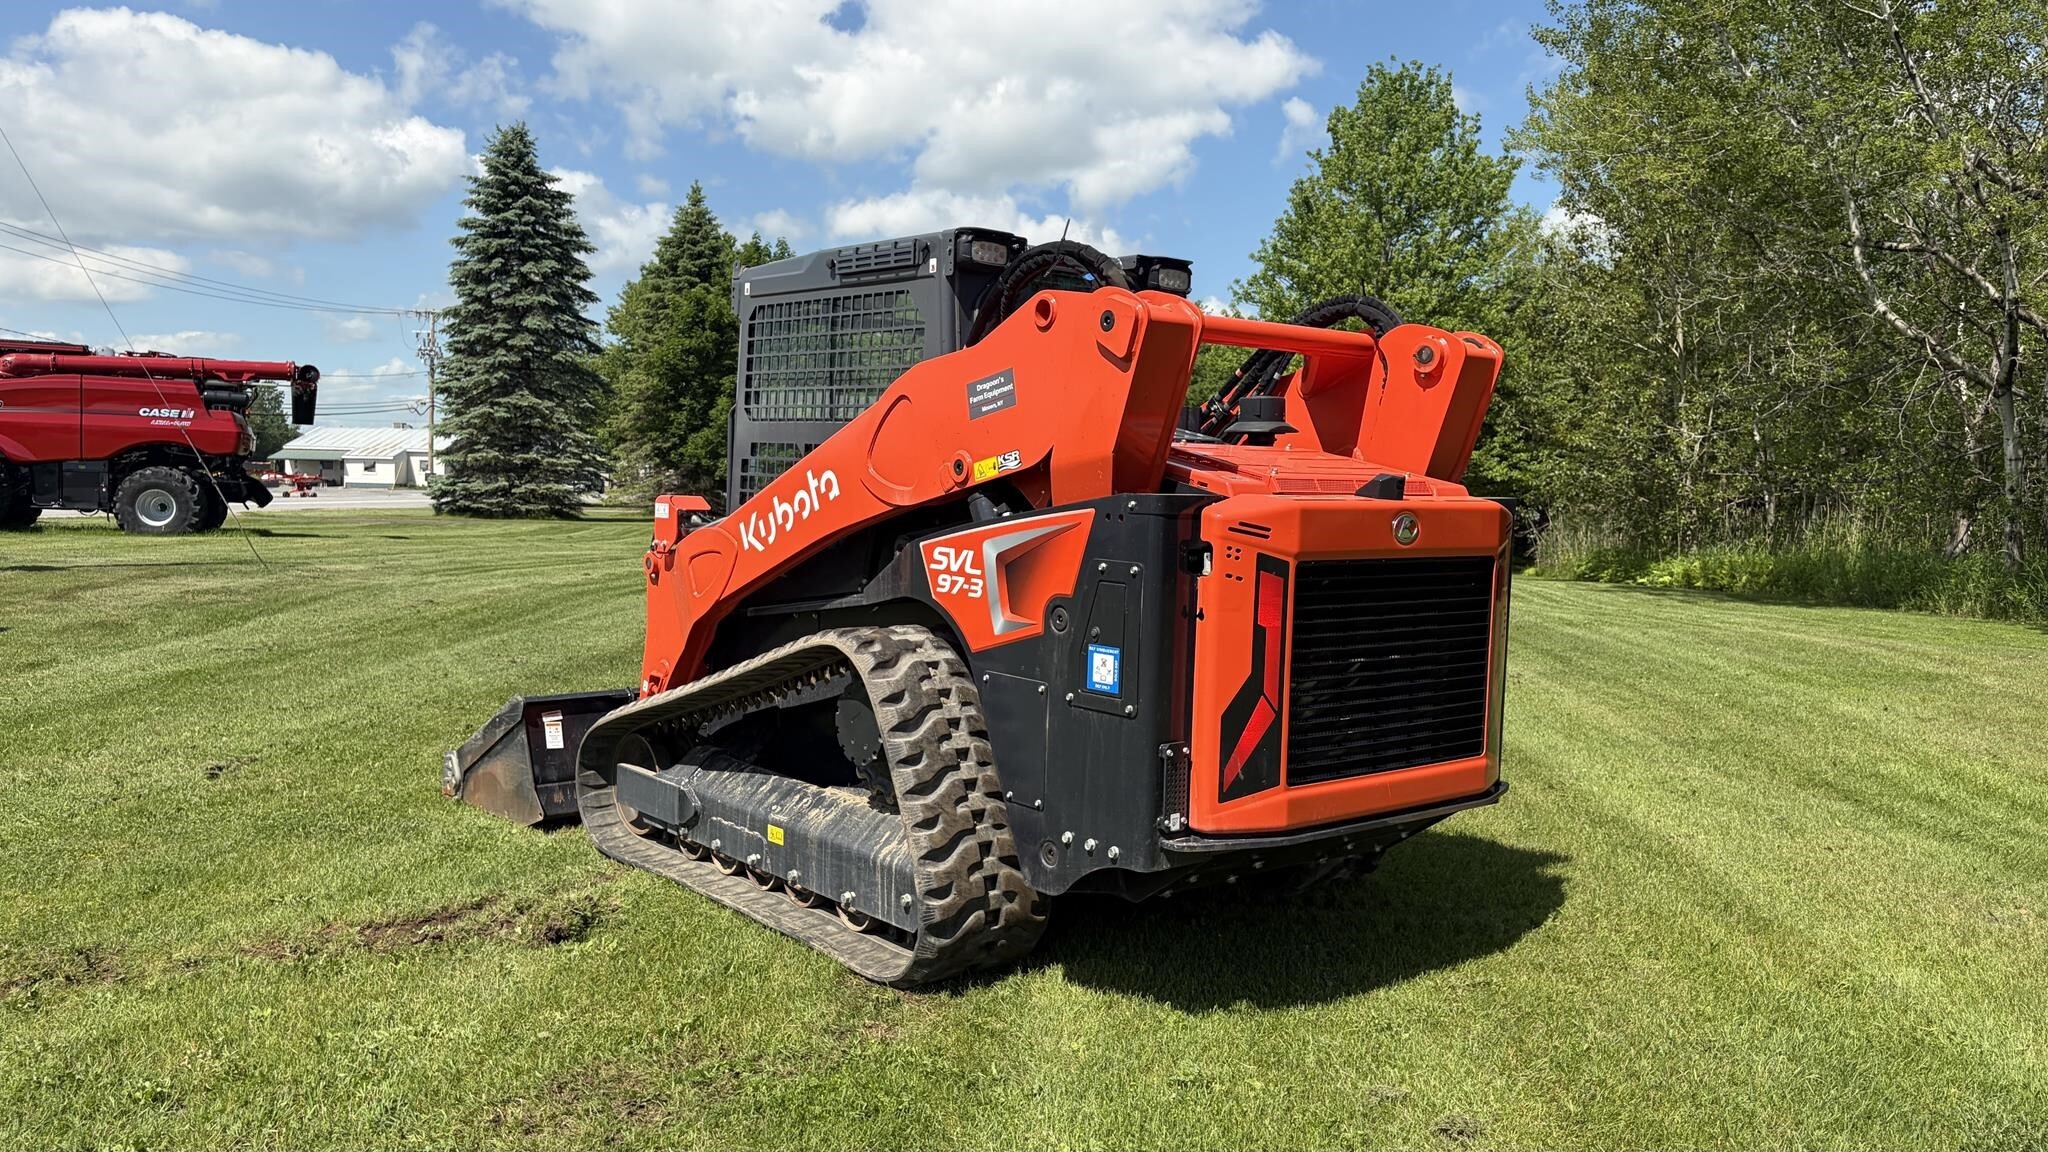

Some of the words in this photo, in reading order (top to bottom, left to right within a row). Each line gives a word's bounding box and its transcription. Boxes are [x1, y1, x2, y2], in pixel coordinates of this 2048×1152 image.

[969, 394, 984, 405] Farm
[983, 382, 1014, 399] Equipment
[976, 376, 1005, 392] Dragoon's
[138, 407, 180, 418] CASE
[997, 450, 1020, 464] KSR
[739, 469, 841, 552] Kubota
[929, 546, 982, 576] SVL
[936, 573, 984, 599] 97-3
